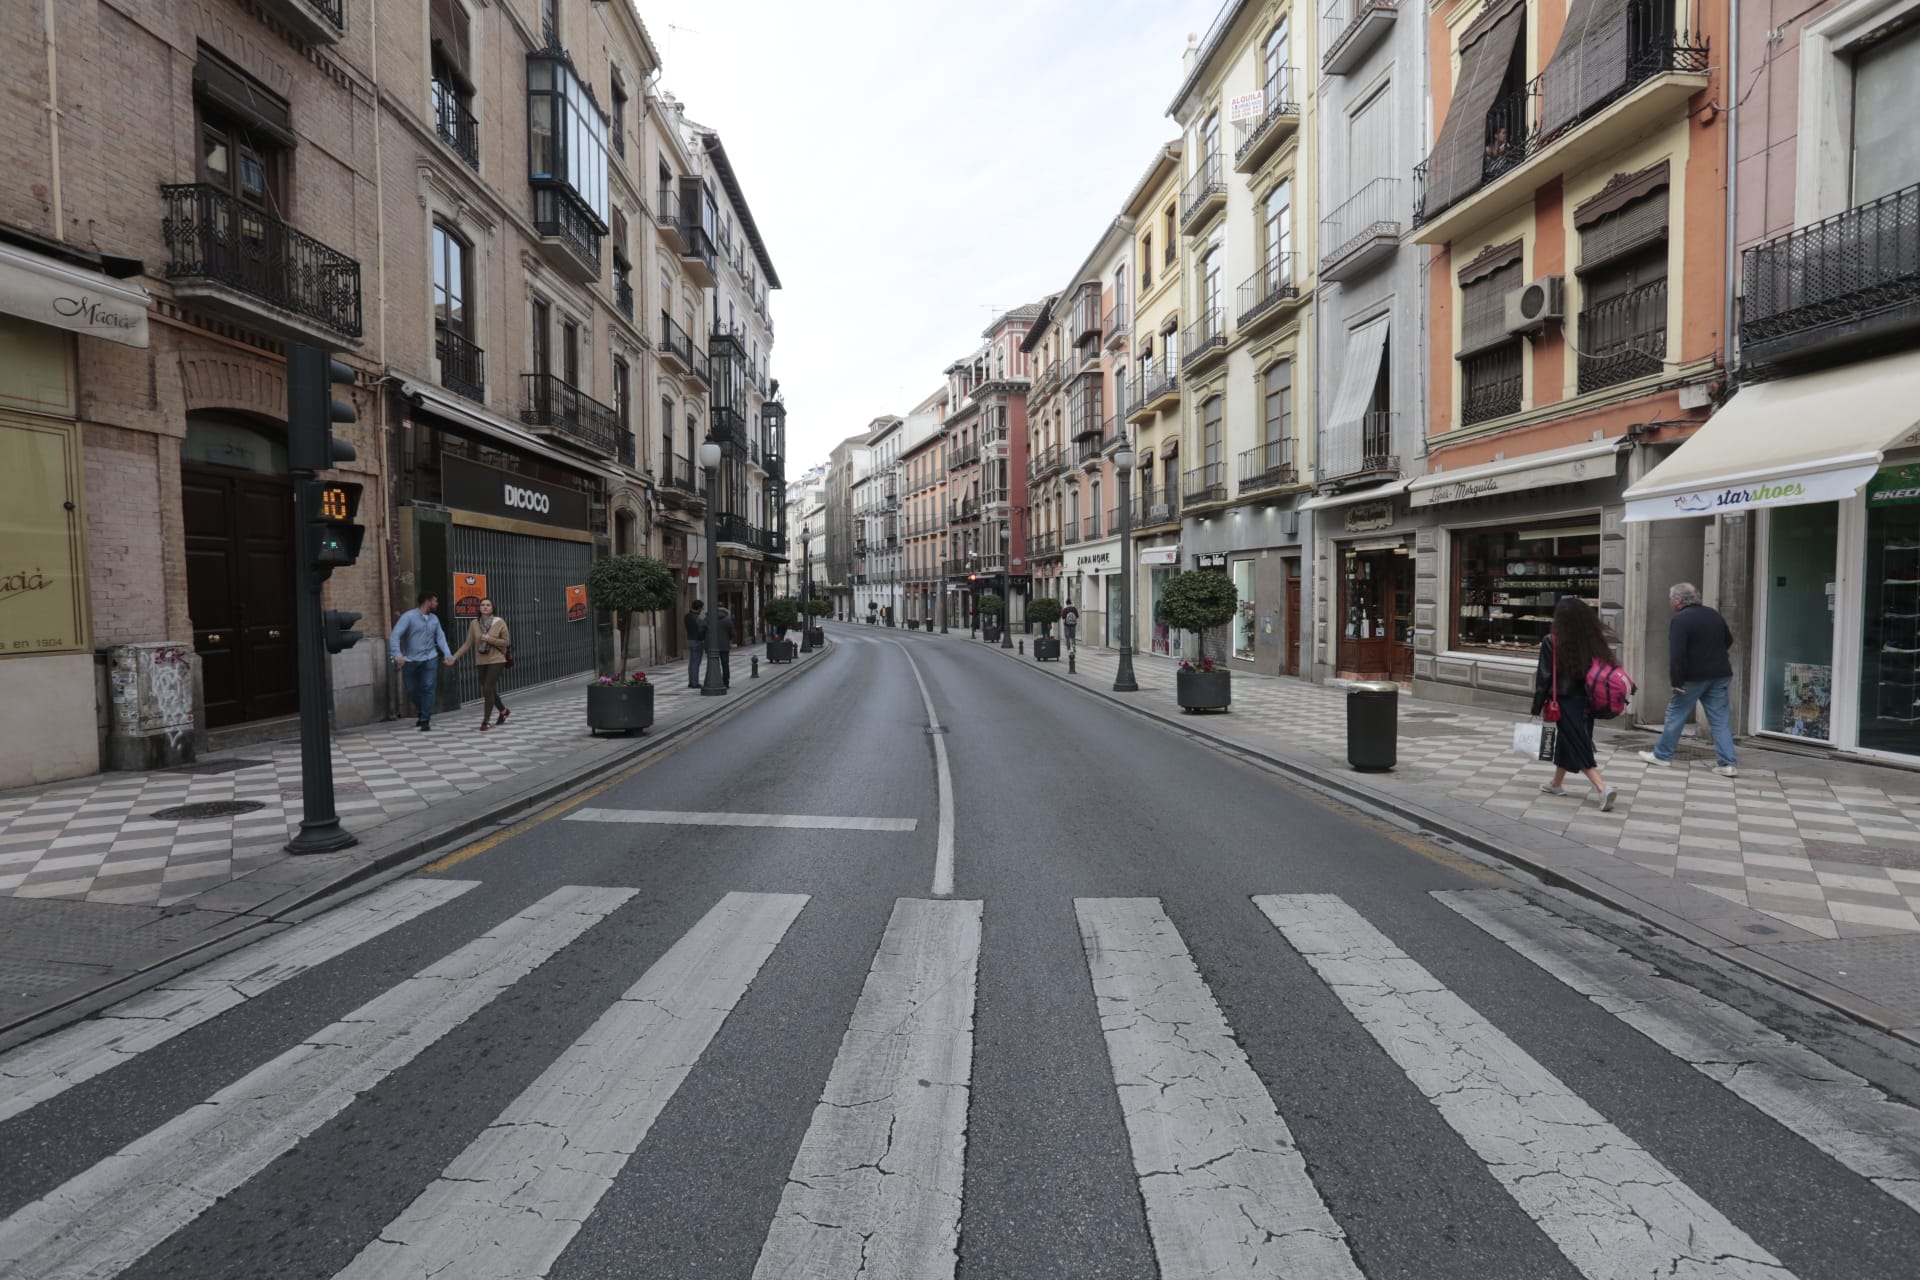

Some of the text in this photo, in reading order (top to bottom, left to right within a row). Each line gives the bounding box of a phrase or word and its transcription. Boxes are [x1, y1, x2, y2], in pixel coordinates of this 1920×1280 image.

[1231, 91, 1262, 105] ALQUILA
[322, 488, 347, 519] 10
[505, 484, 549, 514] DICOCO
[1717, 484, 1805, 505] starshoes
[1077, 552, 1110, 567] ZARA HOME
[13, 640, 29, 649] en
[36, 638, 62, 648] 1904
